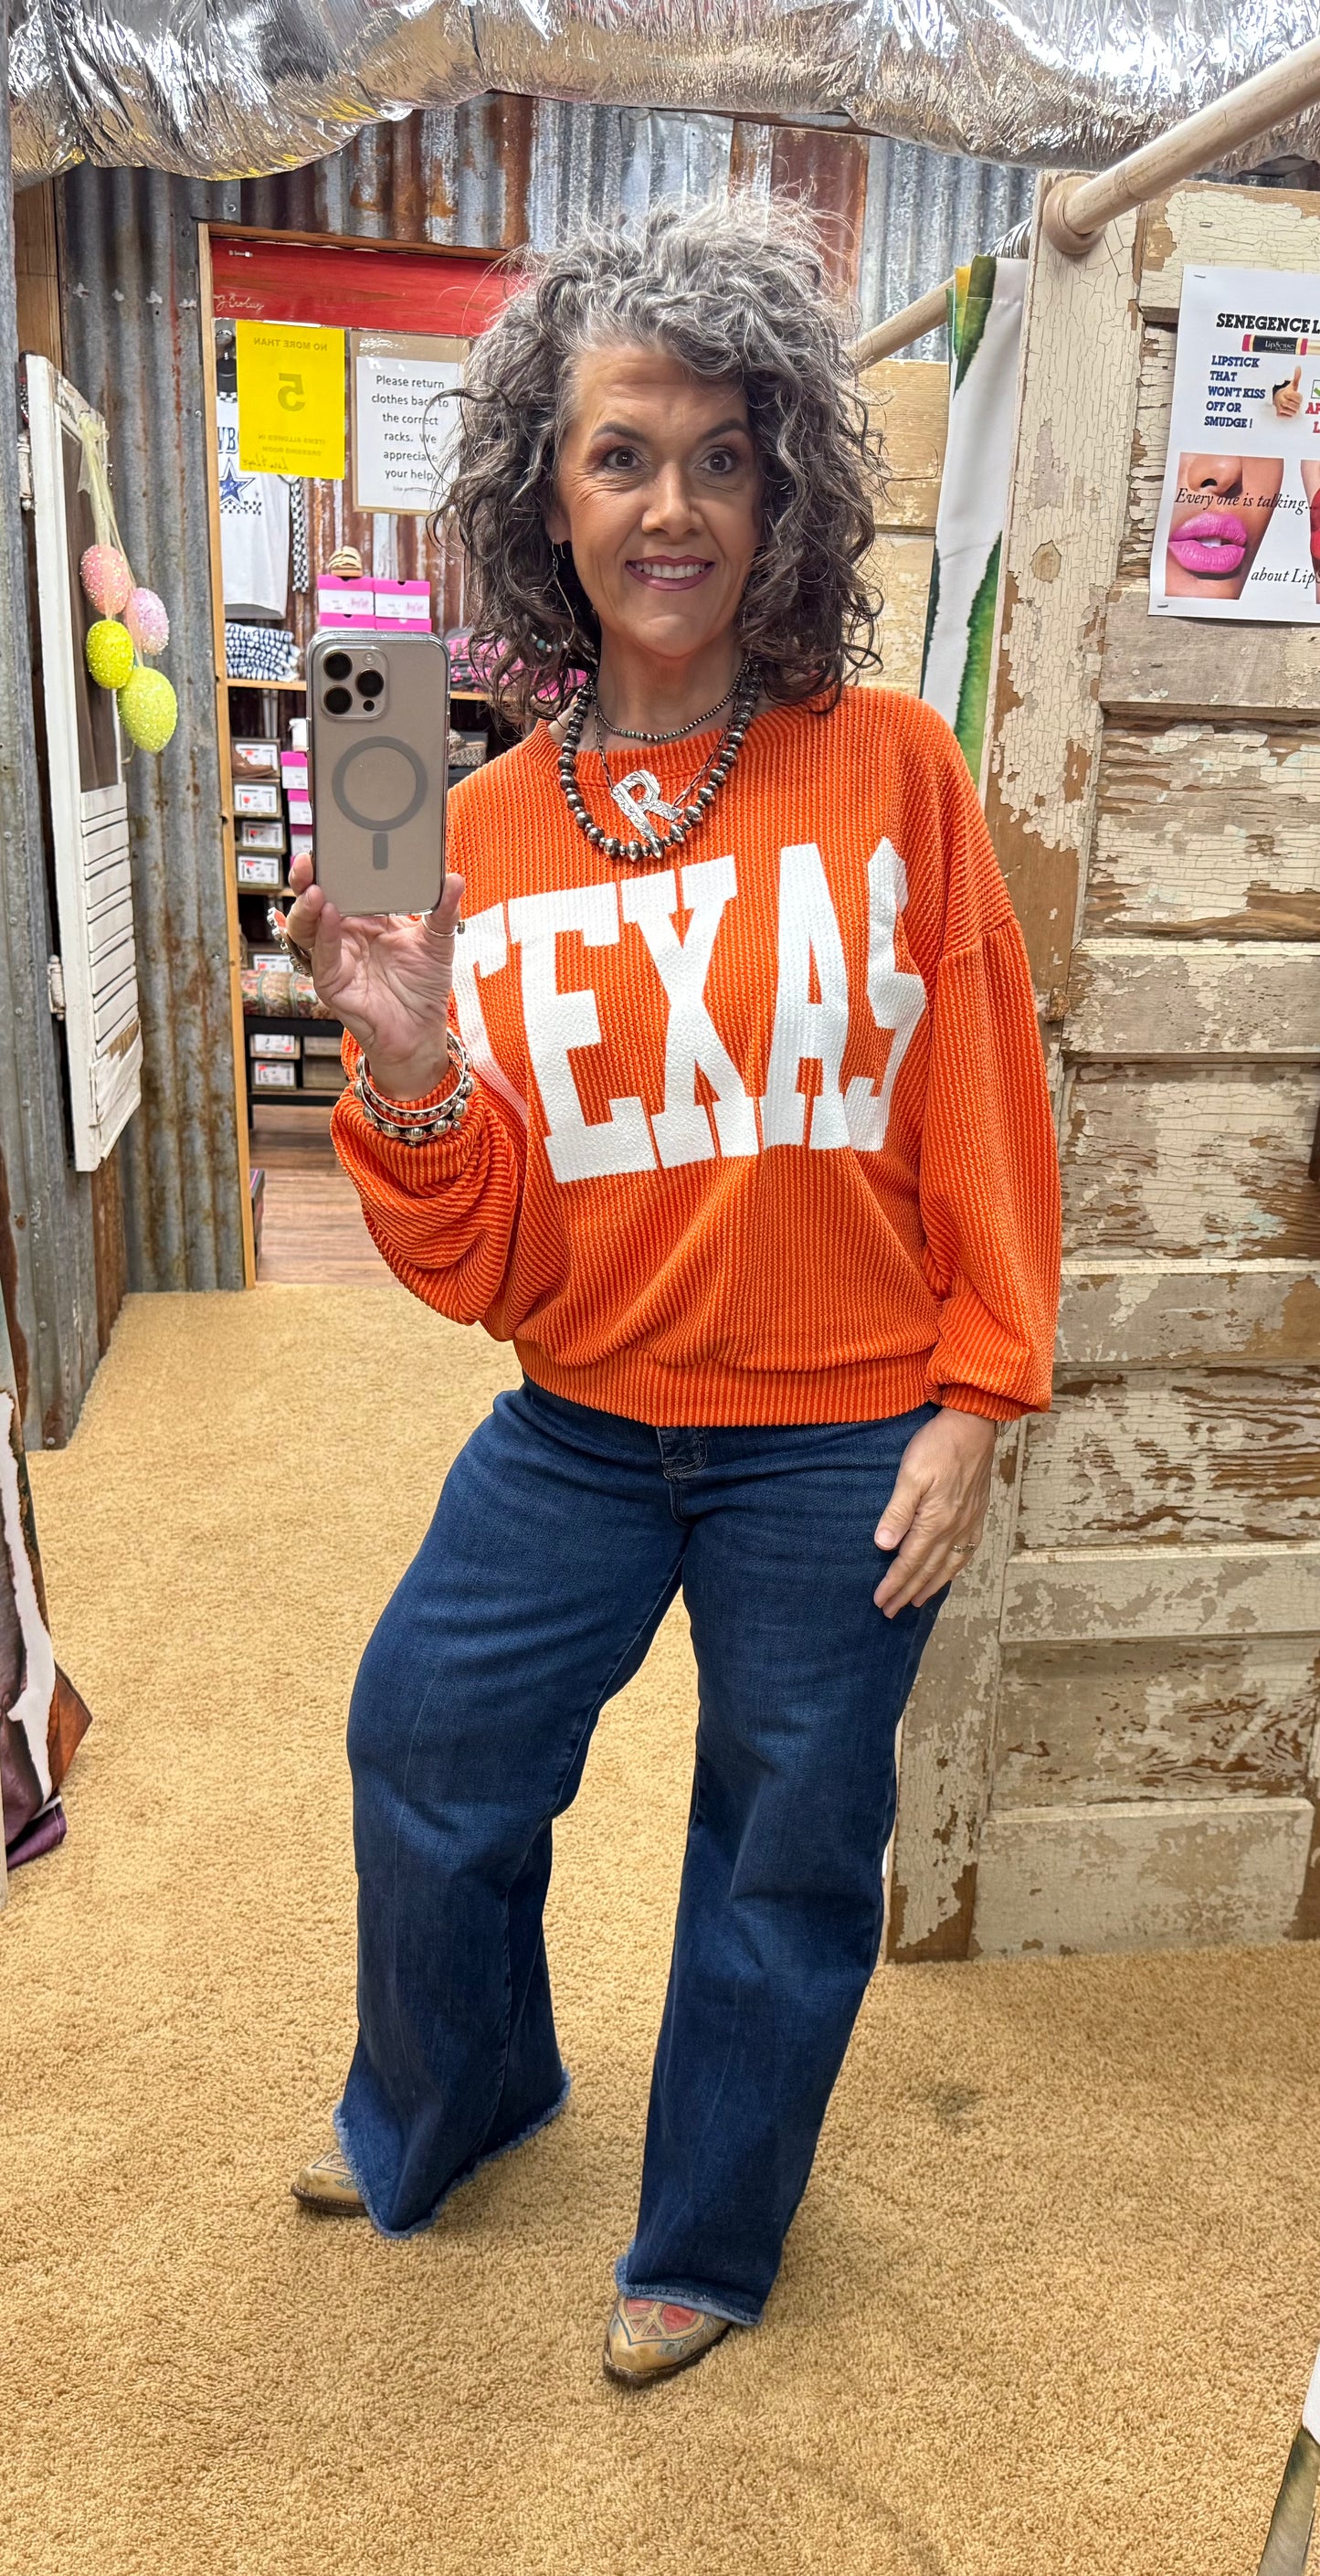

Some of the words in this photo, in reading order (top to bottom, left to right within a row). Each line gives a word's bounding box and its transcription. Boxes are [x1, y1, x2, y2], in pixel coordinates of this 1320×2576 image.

[1216, 313, 1311, 334] SENEGENCE
[1211, 355, 1261, 367] LIPSTICK
[375, 375, 409, 387] Please
[411, 378, 445, 389] return
[1209, 370, 1238, 382] THAT
[1208, 386, 1243, 398] WON'T
[1242, 387, 1266, 399] KISS
[371, 393, 408, 405] clothes
[411, 396, 435, 407] bac
[438, 398, 449, 408] to
[1206, 400, 1226, 412] OFF
[1226, 402, 1242, 413] OR
[382, 412, 399, 423] the
[402, 416, 438, 426] correct
[1204, 416, 1249, 429] SMUDGE
[384, 431, 414, 442] racks.
[419, 433, 437, 444] We
[385, 470, 408, 480] your
[1175, 487, 1214, 511] Every
[1216, 496, 1240, 506] one
[1242, 493, 1253, 506] is
[1251, 567, 1290, 582] about
[452, 836, 926, 1184] TEXAS
